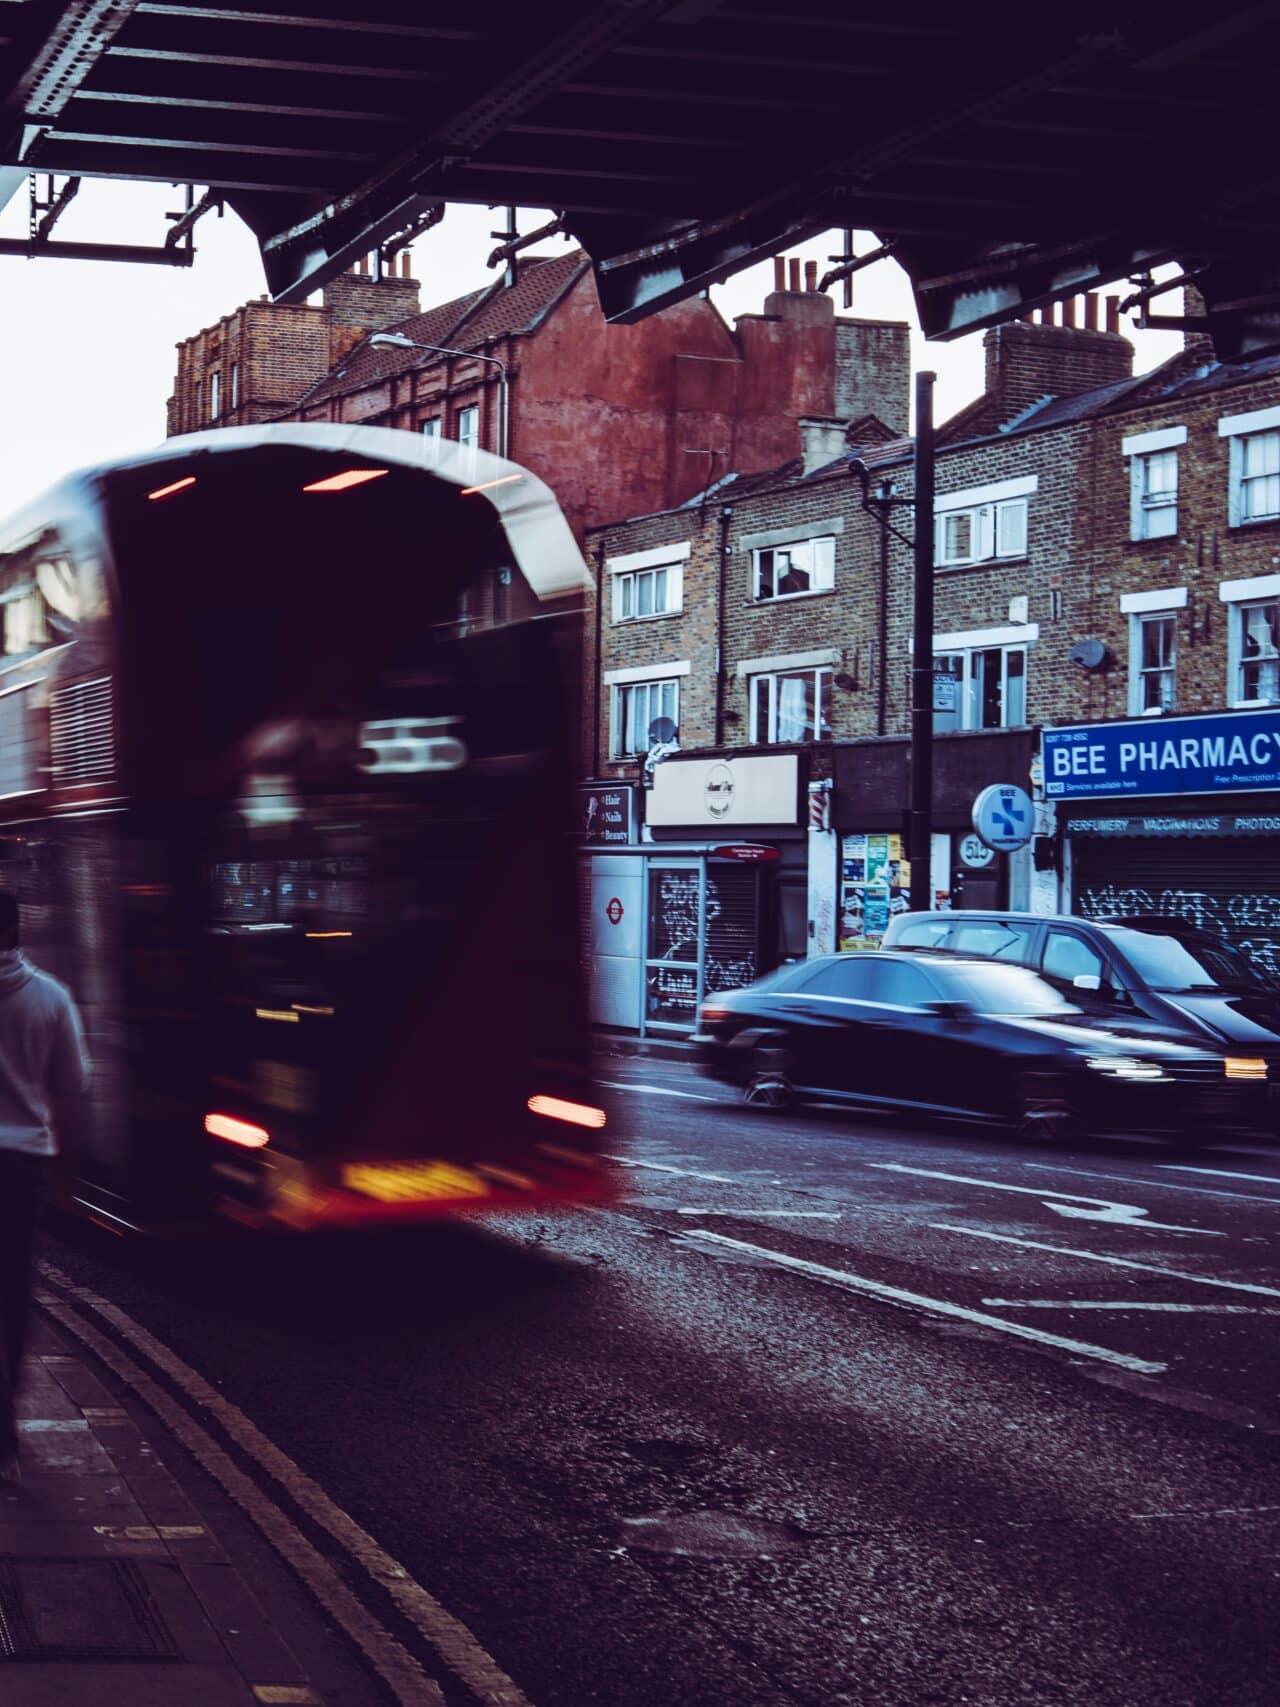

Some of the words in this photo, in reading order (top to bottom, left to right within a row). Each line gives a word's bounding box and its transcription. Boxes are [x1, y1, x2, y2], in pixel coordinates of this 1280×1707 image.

[1053, 745, 1107, 776] BEE
[605, 794, 621, 806] Hair
[605, 811, 623, 823] Nails
[605, 829, 628, 842] Beauty
